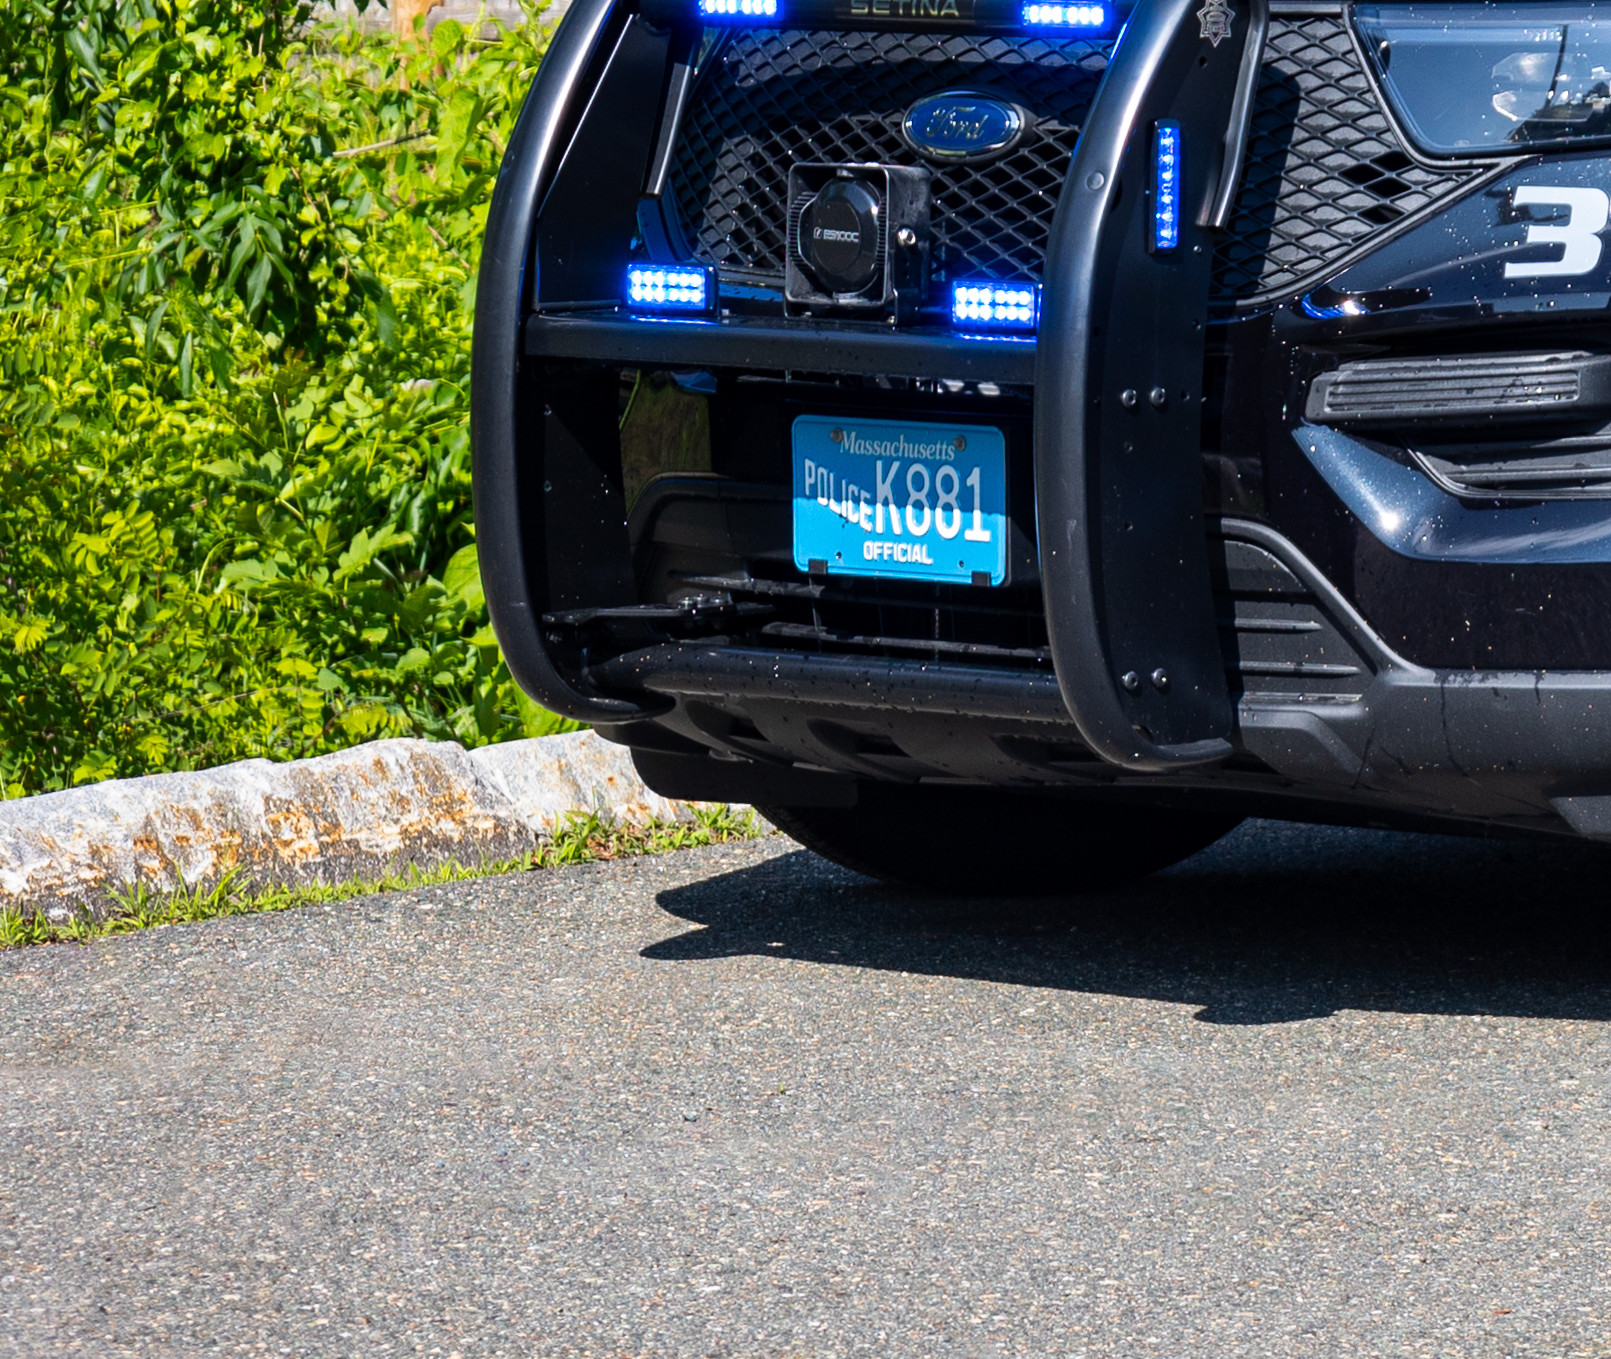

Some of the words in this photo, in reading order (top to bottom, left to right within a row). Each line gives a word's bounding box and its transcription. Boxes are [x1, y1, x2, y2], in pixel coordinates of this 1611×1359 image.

[926, 106, 989, 138] Ford
[839, 430, 956, 461] Massachusetts
[804, 458, 873, 534] POLICE
[875, 459, 992, 543] K881
[863, 540, 934, 565] OFFICIAL
